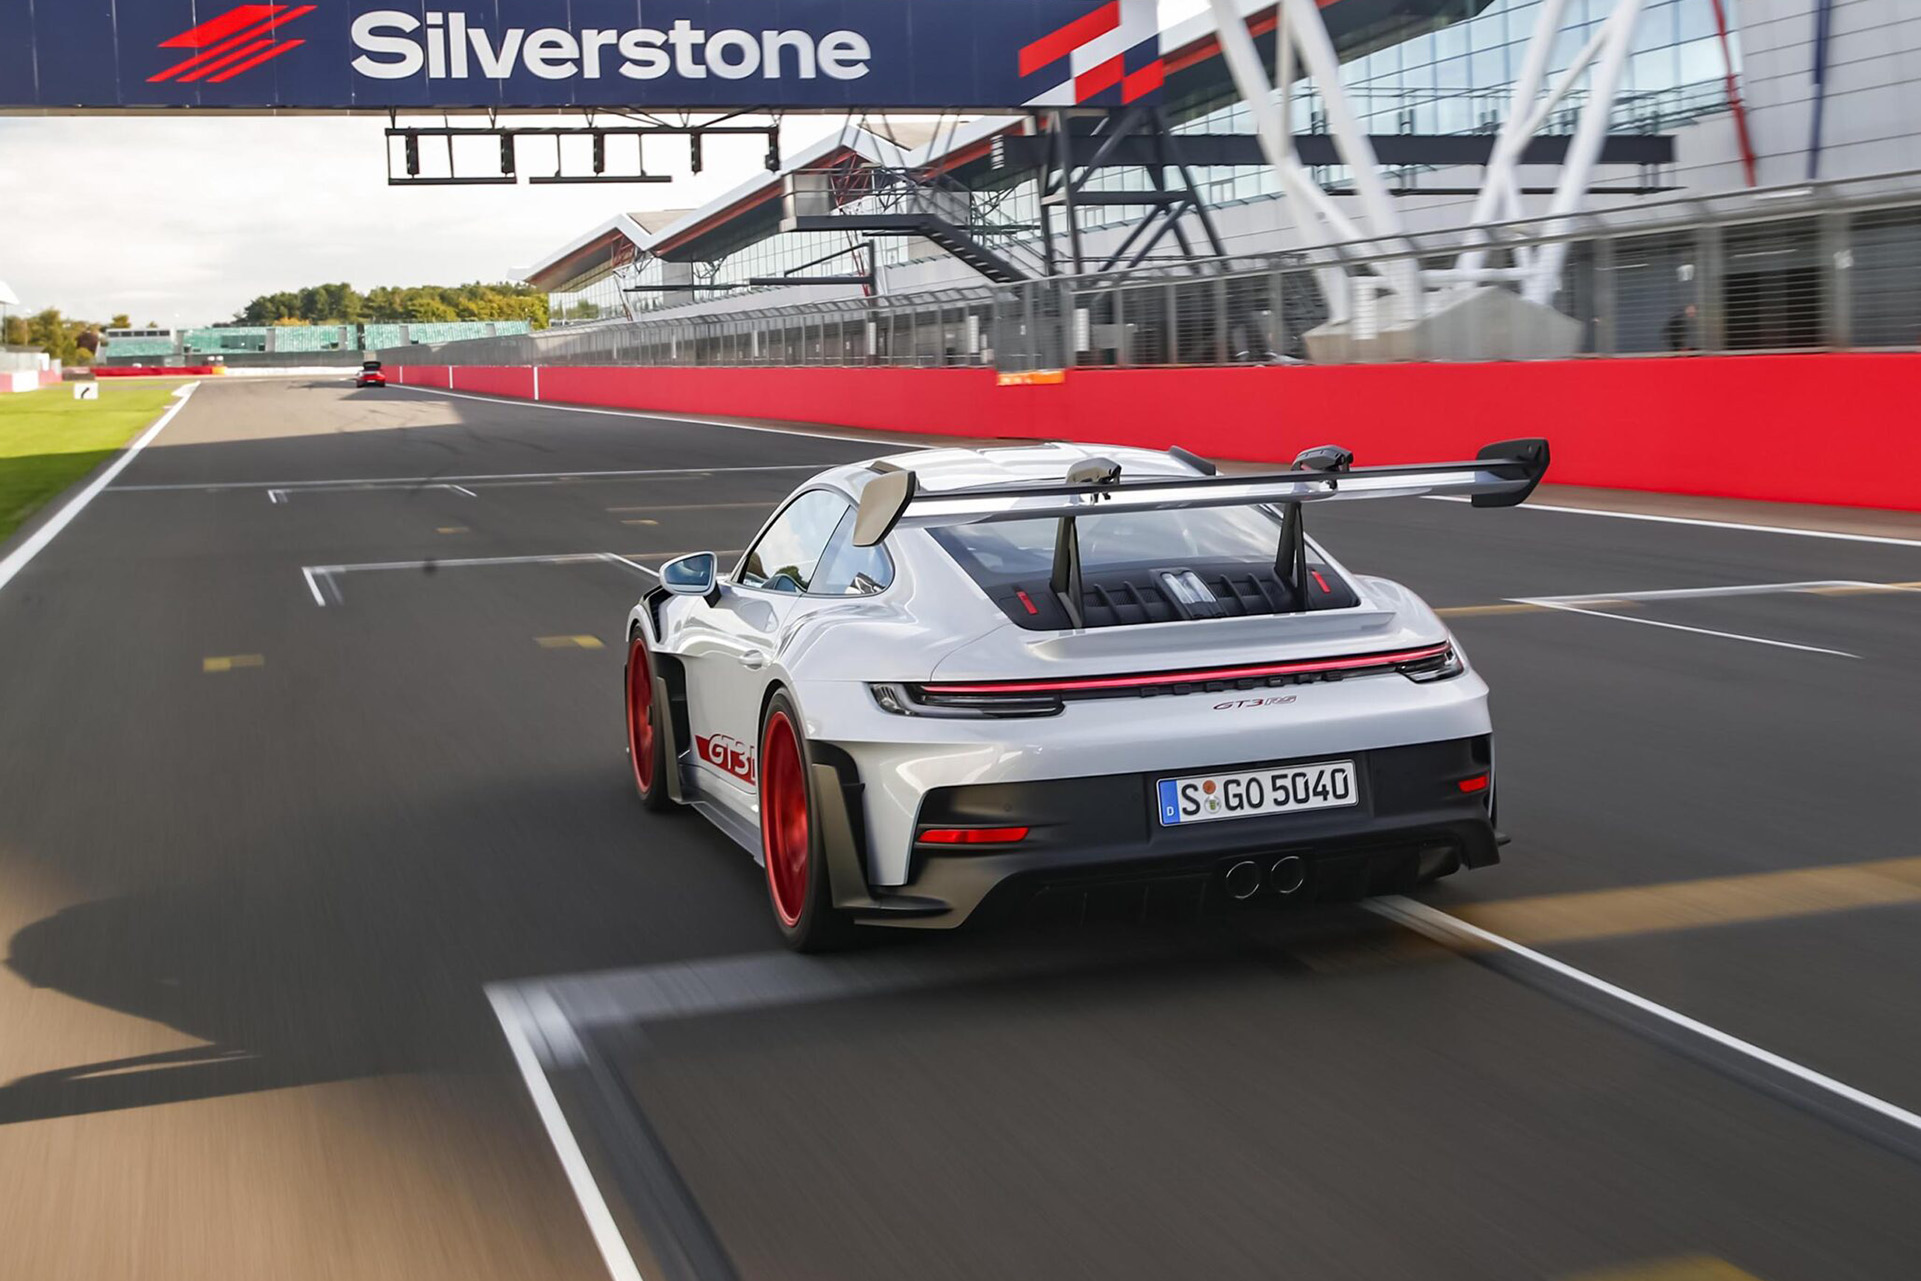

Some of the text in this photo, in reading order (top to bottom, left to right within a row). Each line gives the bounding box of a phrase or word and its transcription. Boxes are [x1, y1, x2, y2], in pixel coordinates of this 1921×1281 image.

[350, 9, 872, 81] Silverstone
[1166, 805, 1175, 817] D
[1181, 768, 1350, 816] S GO 5040
